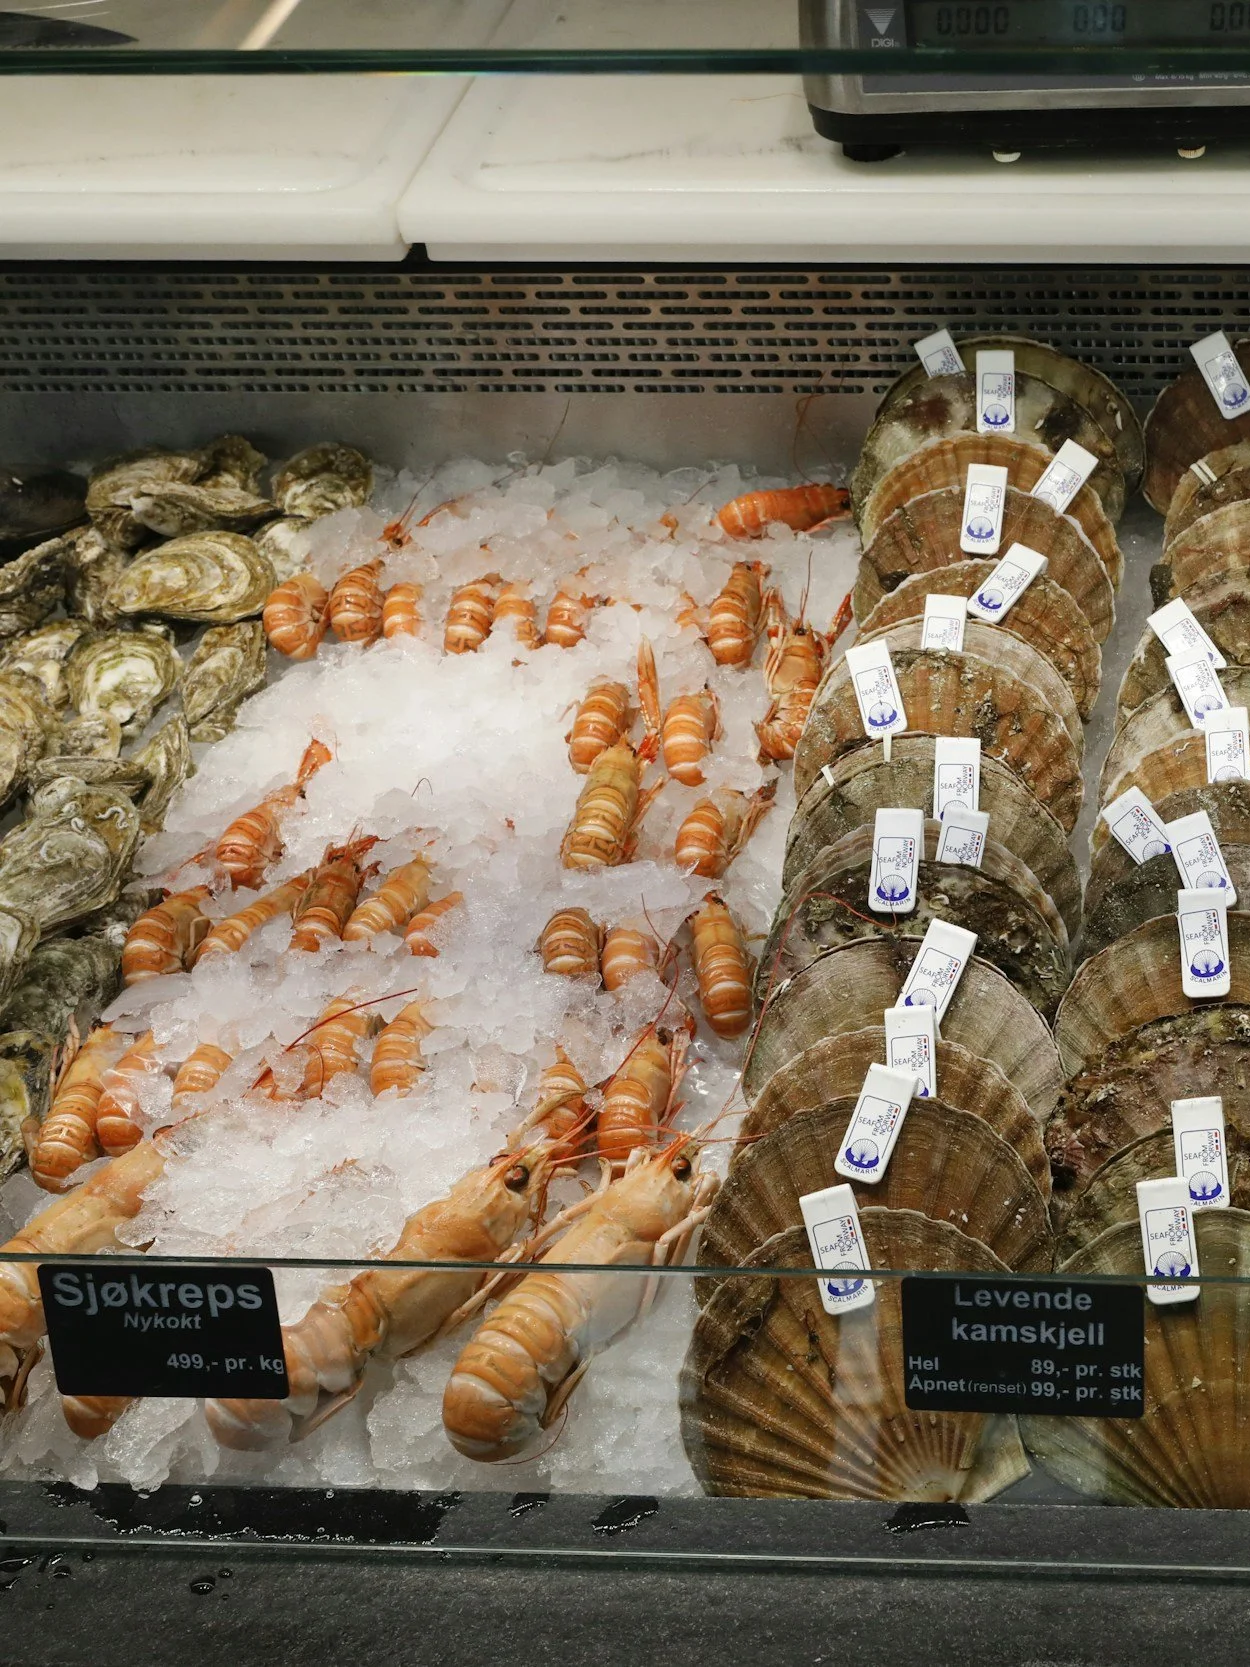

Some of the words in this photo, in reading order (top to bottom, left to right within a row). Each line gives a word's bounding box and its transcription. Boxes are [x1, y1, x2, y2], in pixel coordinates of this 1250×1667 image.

[871, 38, 894, 48] DIGI
[868, 718, 901, 732] SCALMARIN
[874, 898, 911, 906] SCALMARIN
[1186, 930, 1220, 940] SEAFOOD
[1190, 970, 1228, 984] SCALMARIN
[894, 1056, 929, 1066] SEAFOOD
[1184, 1150, 1222, 1160] SEAFOOD
[840, 1157, 878, 1175] SCALMARIN
[1150, 1229, 1188, 1240] SEAFOOD
[820, 1238, 859, 1254] SEAFOOD
[53, 1272, 263, 1318] Sjøkreps
[828, 1284, 868, 1303] SCALMARIN
[954, 1283, 1092, 1310] Levende
[124, 1312, 202, 1332] Nykokt
[952, 1317, 1104, 1350] kamskjell
[166, 1353, 218, 1372] 499,-
[224, 1358, 253, 1374] pr.
[260, 1354, 284, 1374] kg
[908, 1356, 940, 1371] Hel
[1031, 1359, 1068, 1377] 89,-
[1076, 1364, 1102, 1380] pr.
[1110, 1363, 1142, 1378] stk
[968, 1381, 1027, 1394] (renset)
[1031, 1382, 1068, 1400] 99,-
[1076, 1386, 1102, 1402] pr.
[1110, 1385, 1142, 1400] stk
